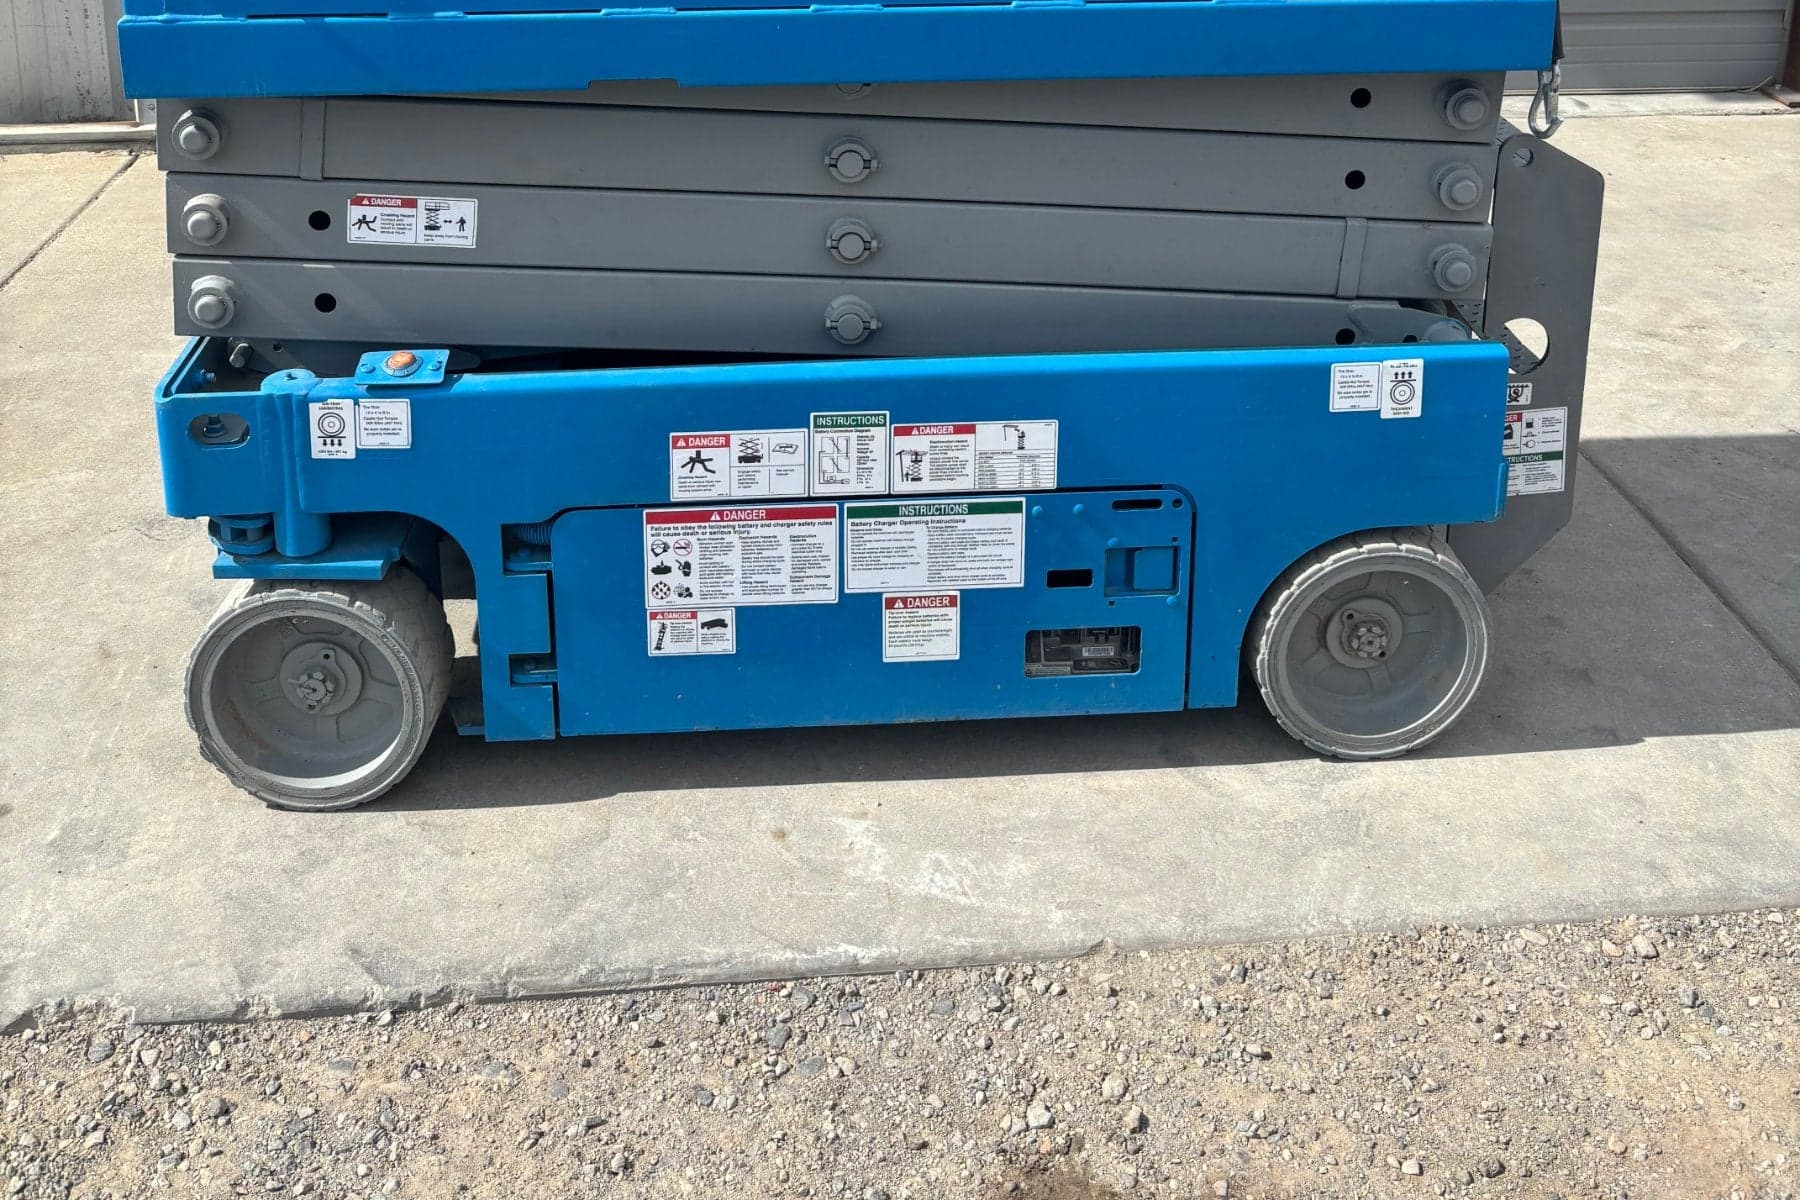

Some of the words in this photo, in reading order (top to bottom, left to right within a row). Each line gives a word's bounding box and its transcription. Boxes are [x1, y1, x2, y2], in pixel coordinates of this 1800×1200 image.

[371, 198, 402, 207] DANGER
[816, 415, 884, 426] INSTRUCTIONS
[919, 426, 954, 435] DANGER
[688, 437, 726, 447] DANGER
[1508, 454, 1543, 463] TRUCTIONS
[899, 504, 969, 516] INSTRUCTIONS
[723, 510, 766, 521] DANGER
[907, 596, 950, 608] DANGER
